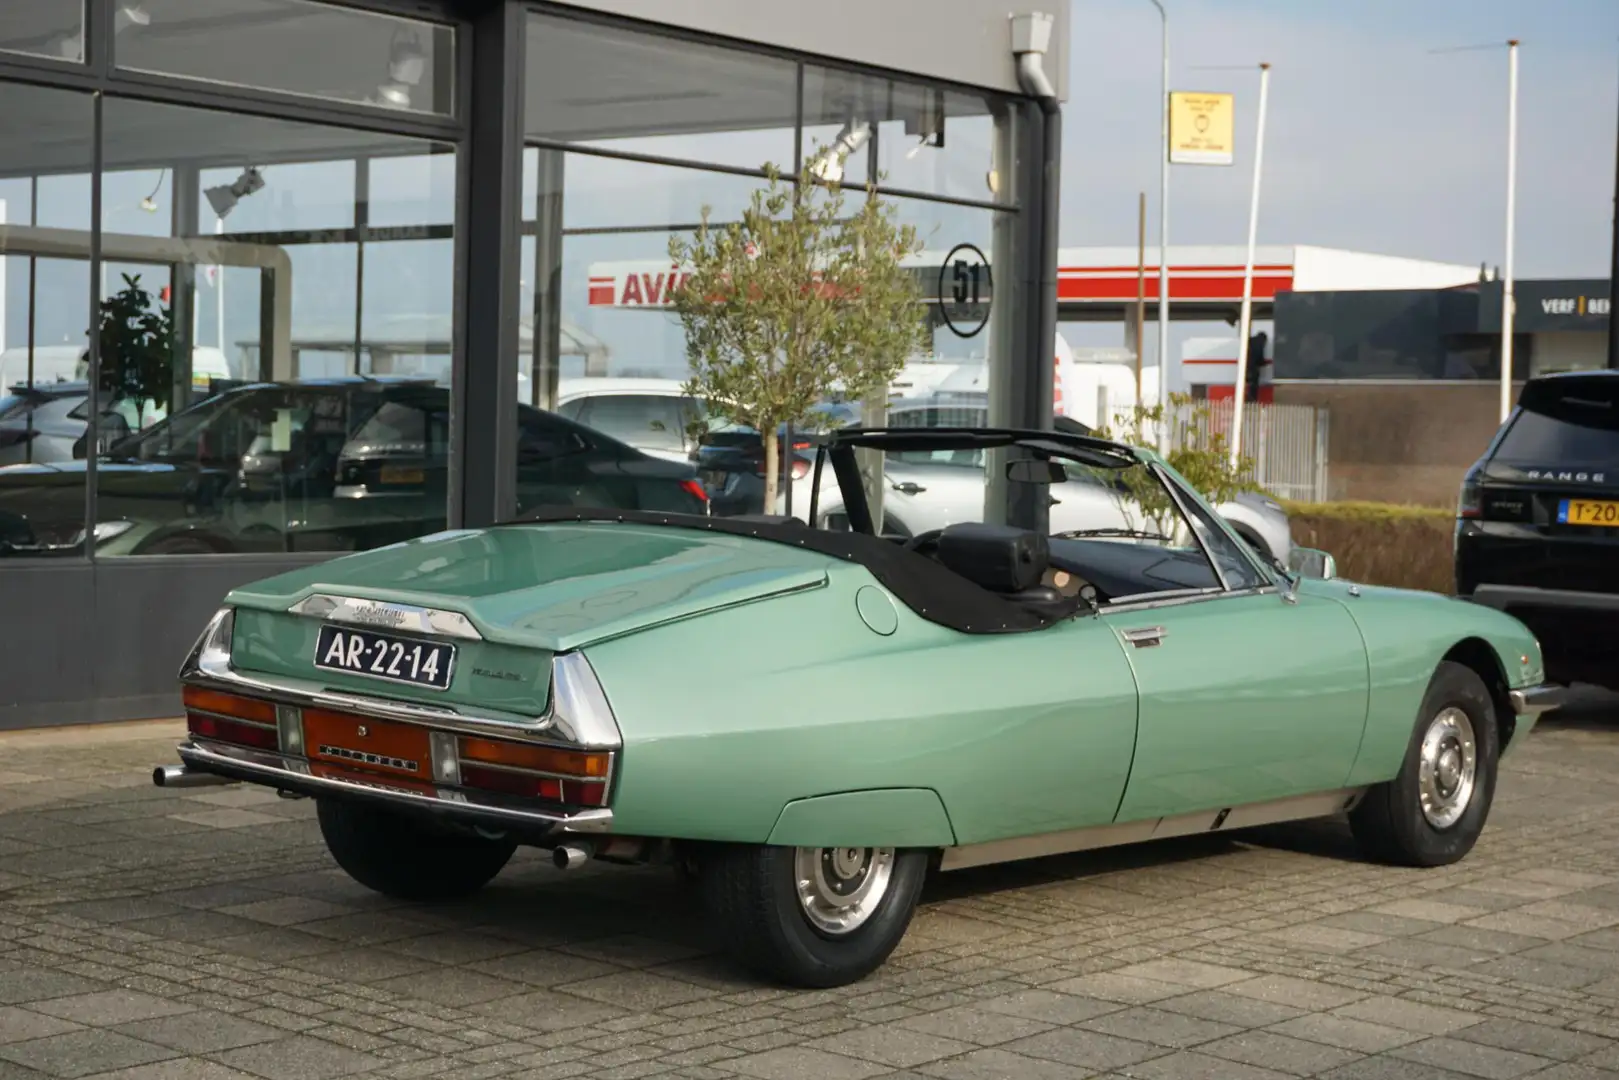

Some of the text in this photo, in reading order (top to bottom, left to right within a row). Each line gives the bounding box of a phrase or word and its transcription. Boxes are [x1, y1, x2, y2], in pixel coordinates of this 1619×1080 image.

[953, 259, 980, 303] 51
[1541, 298, 1575, 314] VERF
[1527, 470, 1605, 482] RANGE
[323, 631, 440, 682] AR-22-14
